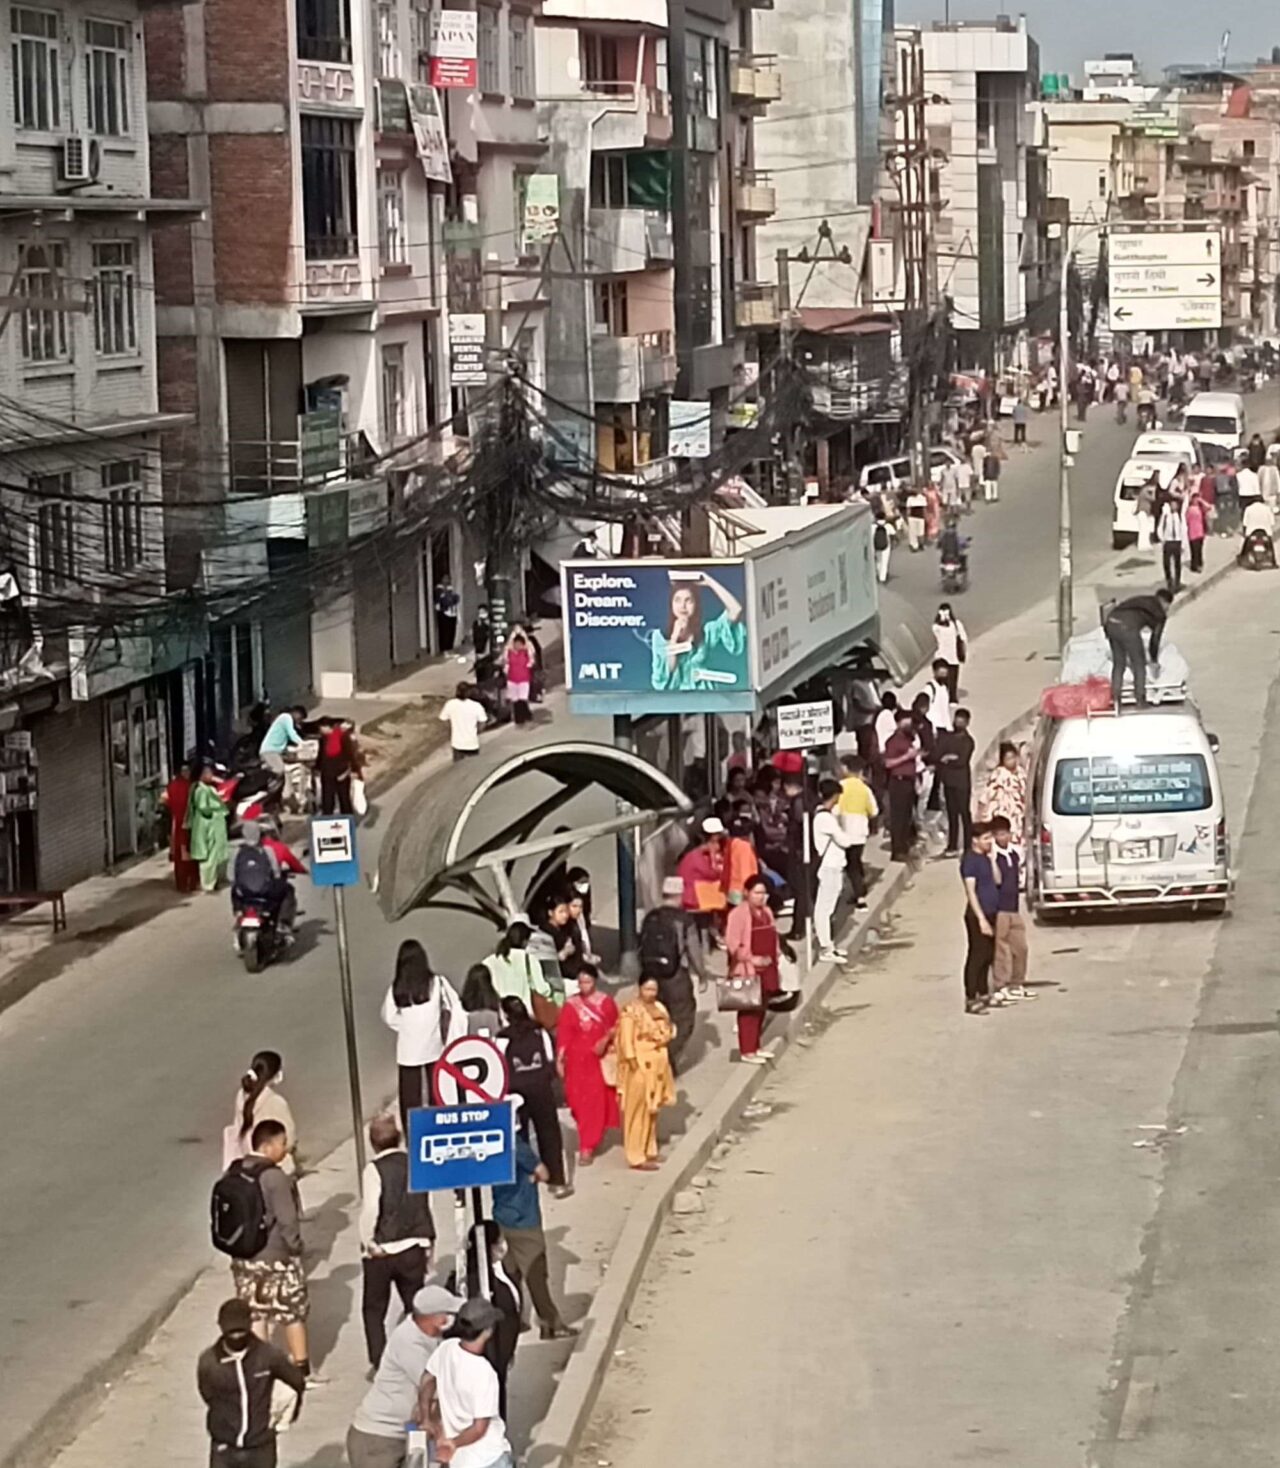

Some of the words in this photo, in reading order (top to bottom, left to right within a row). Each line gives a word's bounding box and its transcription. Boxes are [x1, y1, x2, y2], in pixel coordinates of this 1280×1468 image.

[430, 30, 475, 42] JAPAN
[573, 573, 637, 591] Explore.
[574, 593, 633, 608] Dream.
[575, 611, 647, 628] Discover.
[578, 663, 623, 680] MIT
[435, 1112, 459, 1125] BUS
[460, 1110, 490, 1123] STOP
